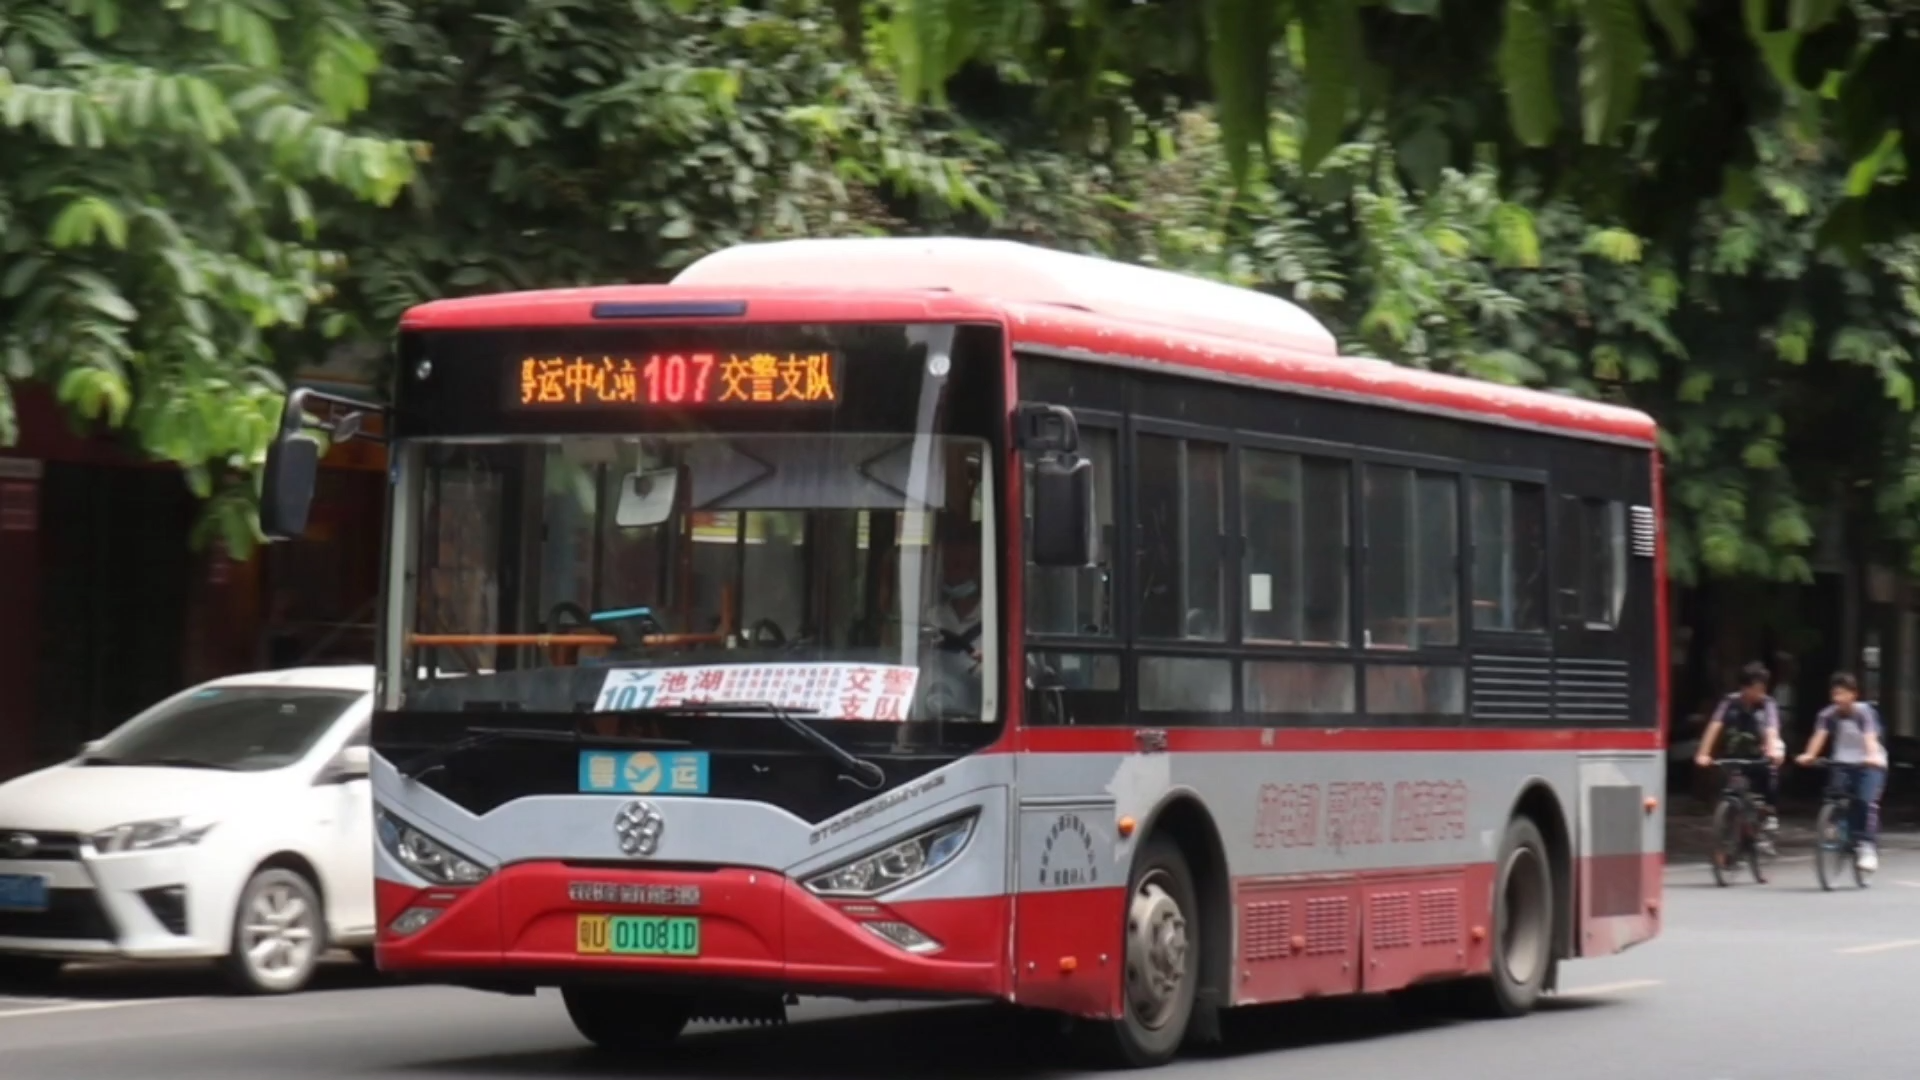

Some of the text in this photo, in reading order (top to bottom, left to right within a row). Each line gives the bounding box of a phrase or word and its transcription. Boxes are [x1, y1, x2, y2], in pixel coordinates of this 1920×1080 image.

[643, 354, 713, 402] 107
[718, 353, 835, 402] 交警支队
[845, 667, 914, 695] 交警
[603, 686, 656, 711] 107
